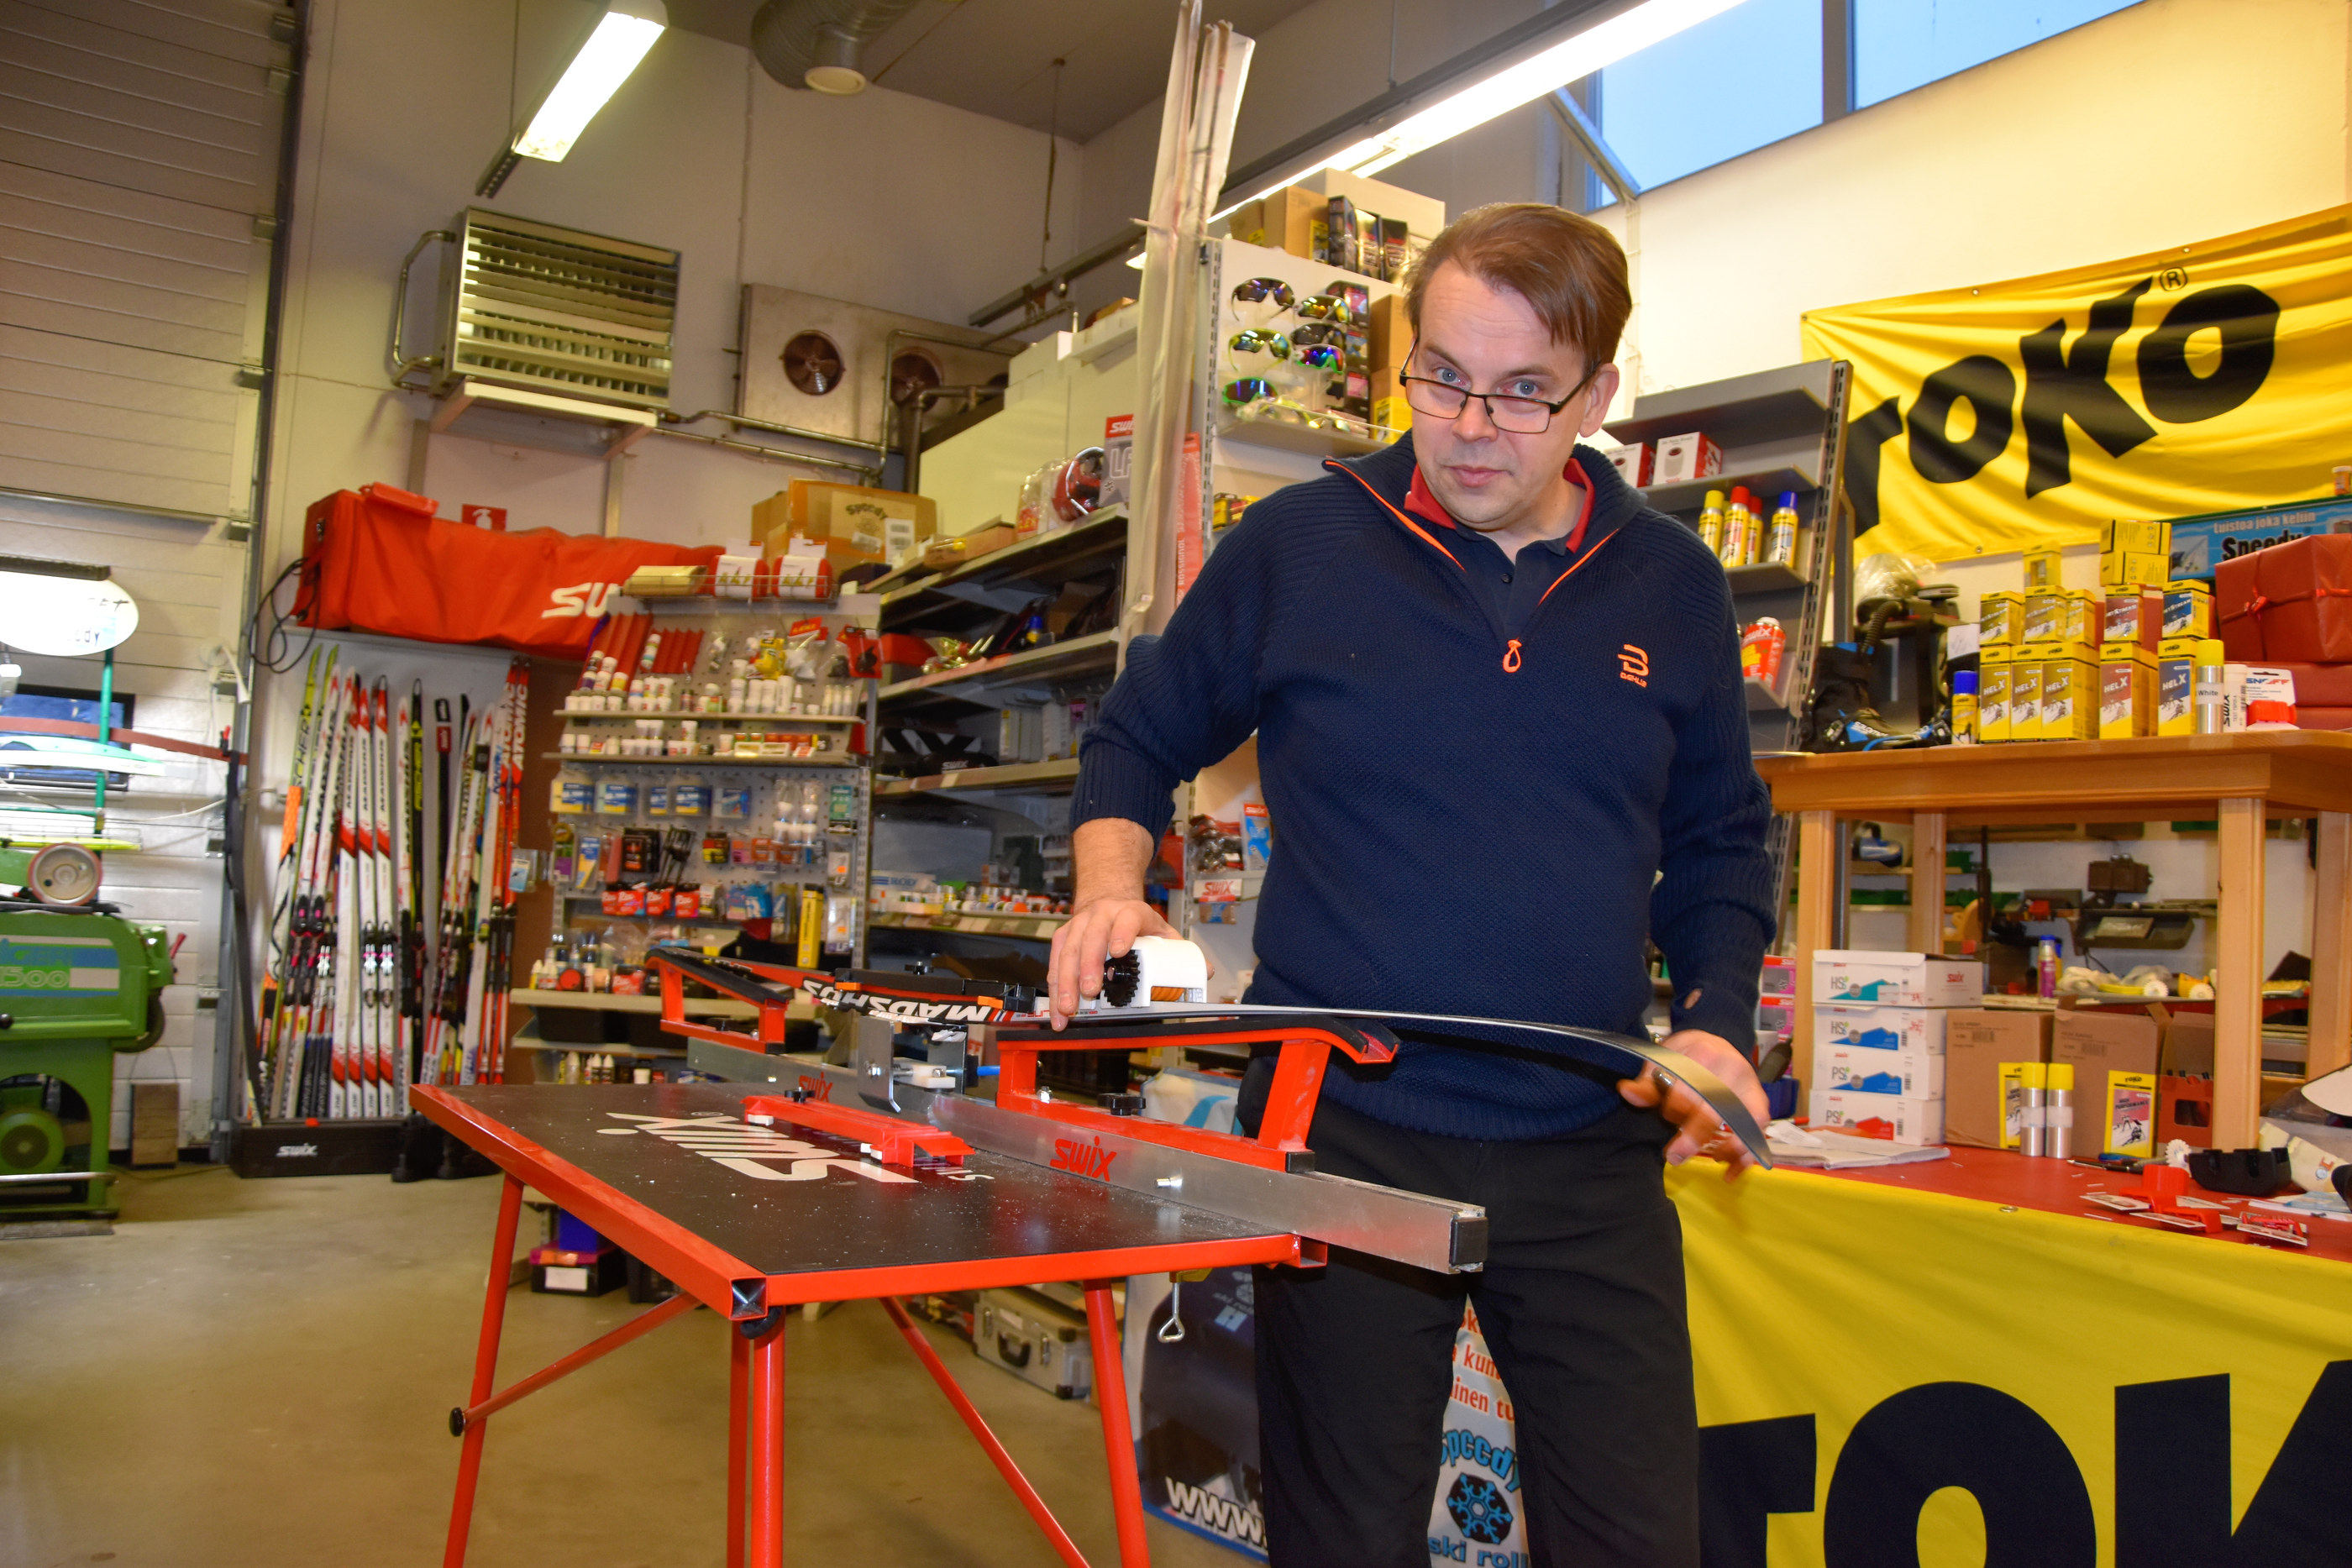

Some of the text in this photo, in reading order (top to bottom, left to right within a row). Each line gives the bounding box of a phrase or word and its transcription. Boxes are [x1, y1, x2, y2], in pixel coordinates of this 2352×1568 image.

[1843, 275, 2281, 539] TOKO
[2213, 511, 2316, 533] Luistoa joka keliin
[512, 683, 528, 770] ATOMIC
[803, 978, 992, 1022] MADSHUS
[276, 1143, 318, 1157] swix
[1049, 1135, 1118, 1183] swix
